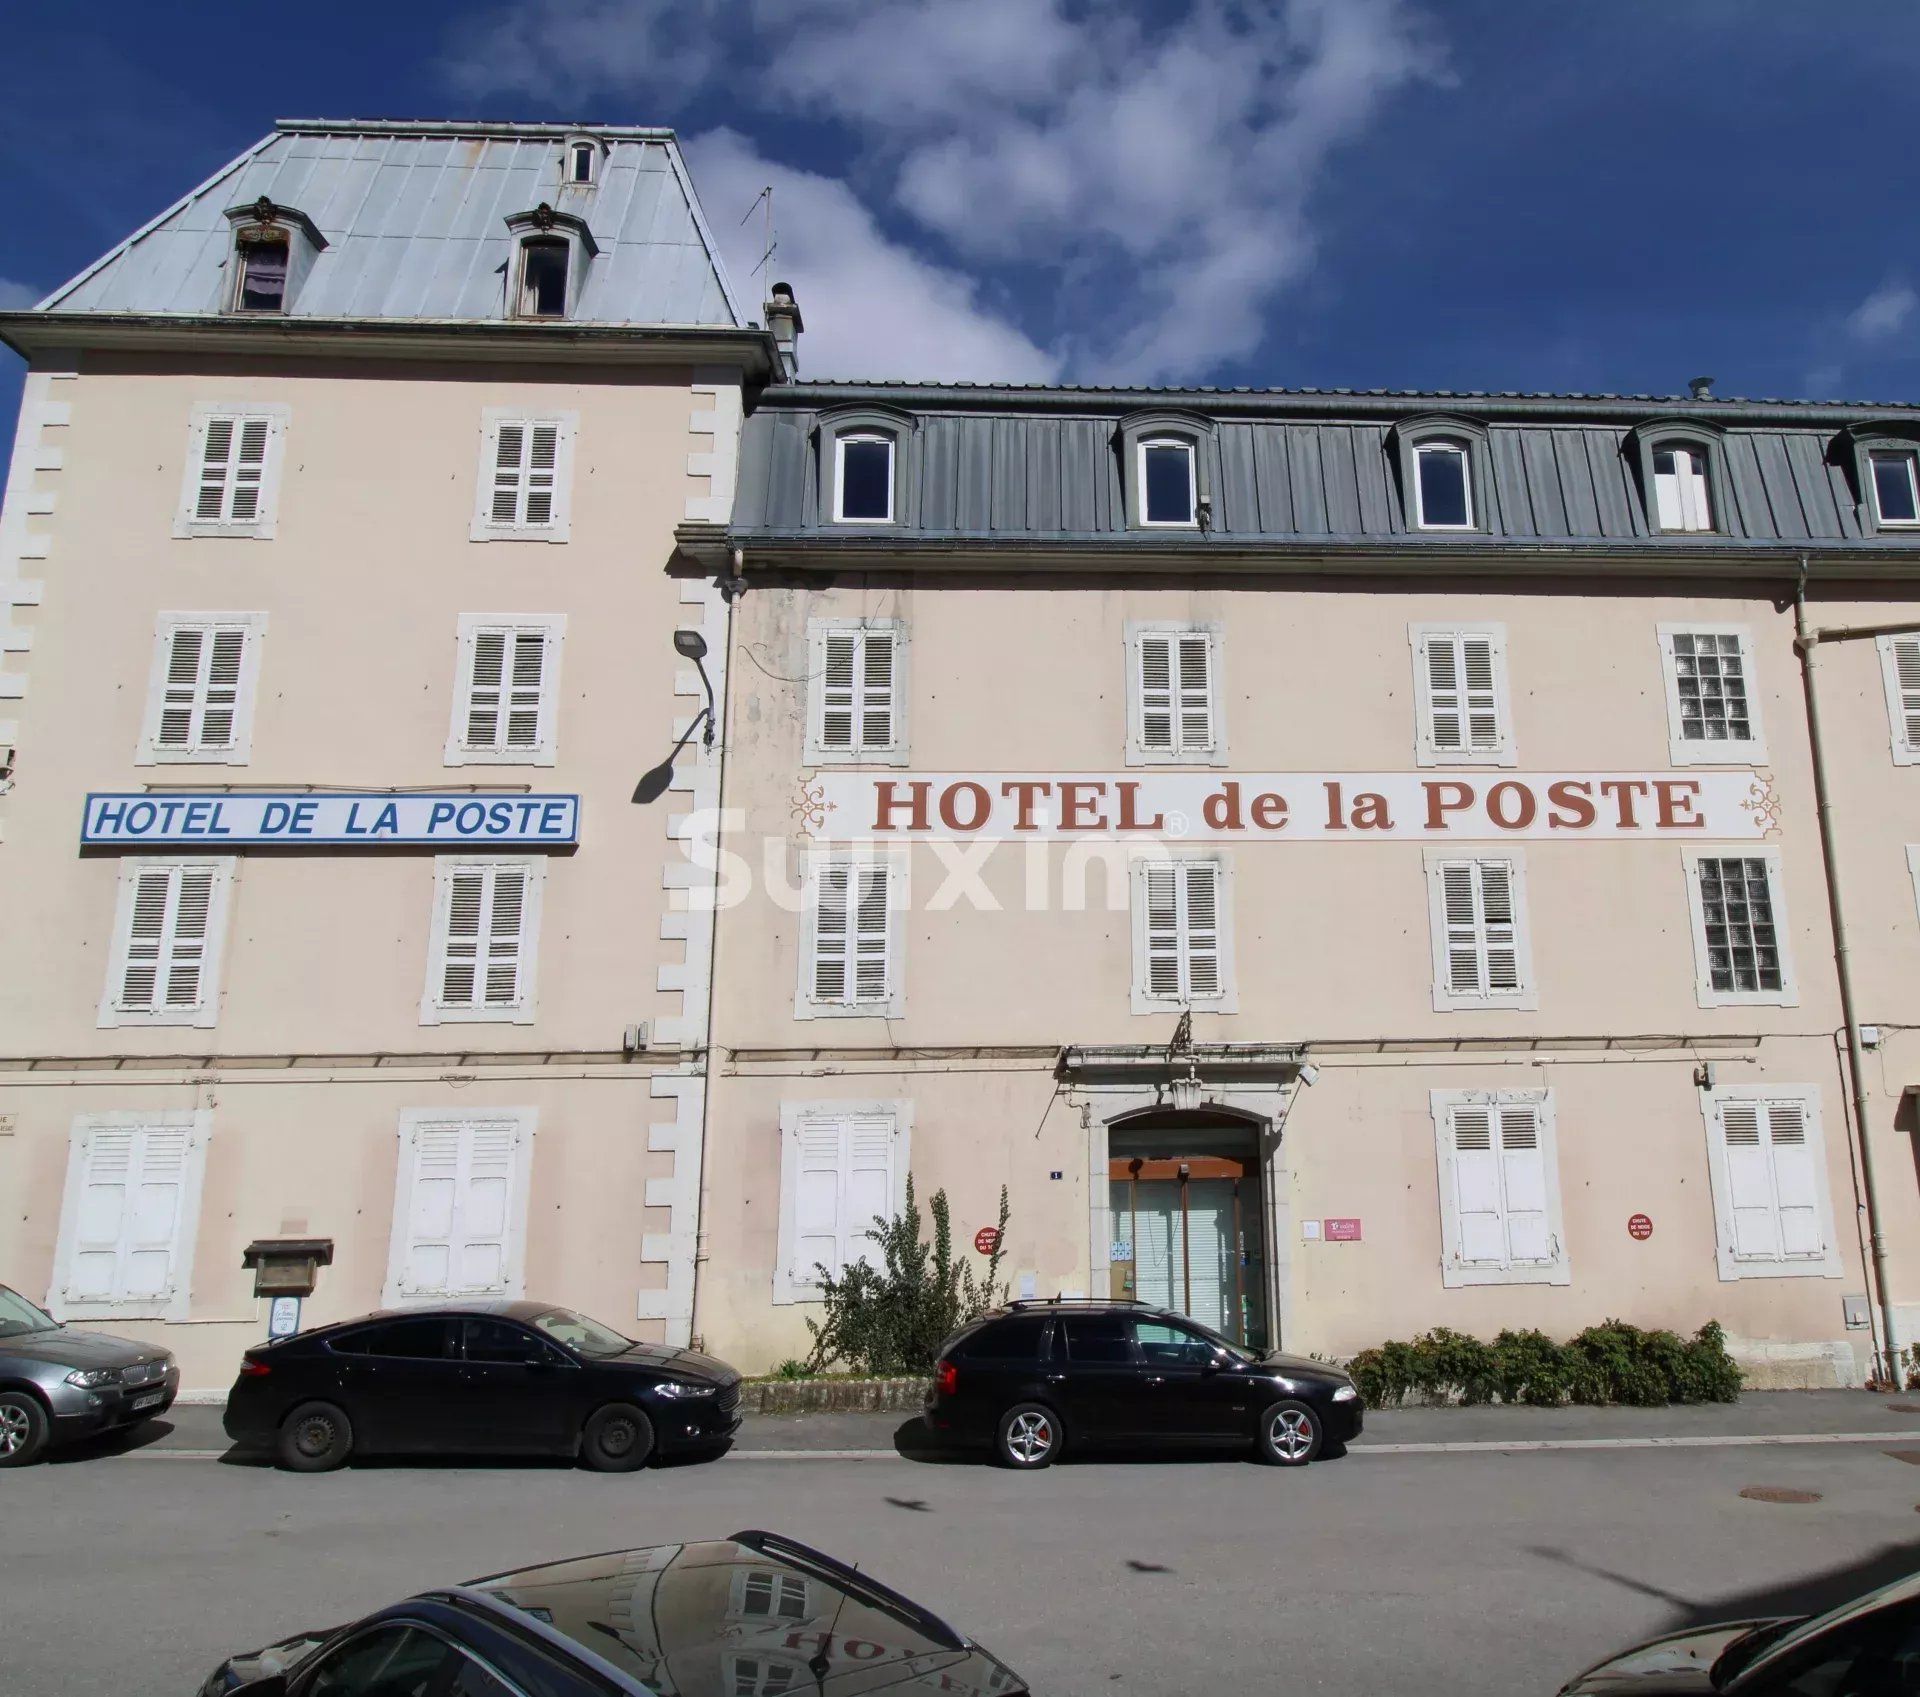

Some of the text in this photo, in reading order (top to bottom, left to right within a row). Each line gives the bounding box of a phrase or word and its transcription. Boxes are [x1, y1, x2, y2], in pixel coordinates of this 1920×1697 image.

[93, 802, 567, 835] HOTEL DE LA POSTE
[871, 780, 1705, 832] HOTEL de la POSTE
